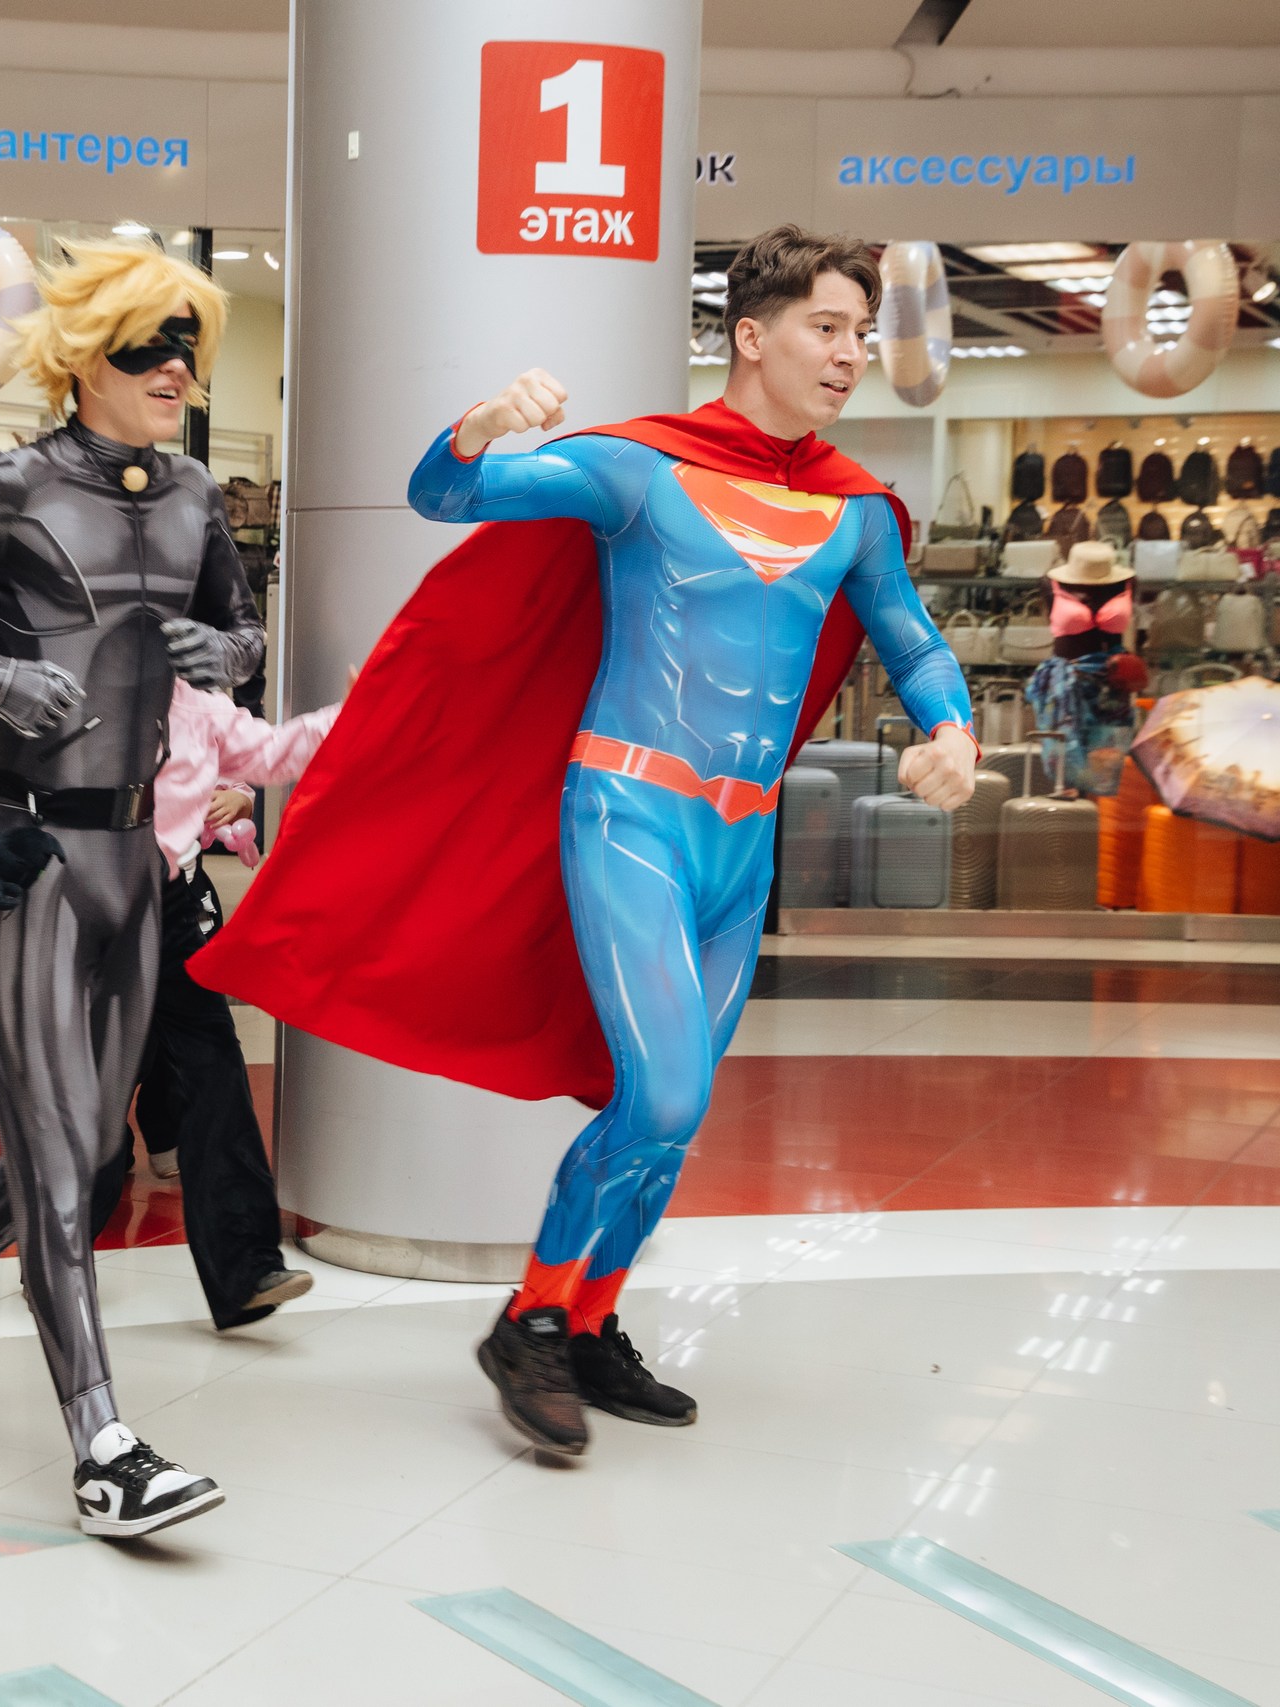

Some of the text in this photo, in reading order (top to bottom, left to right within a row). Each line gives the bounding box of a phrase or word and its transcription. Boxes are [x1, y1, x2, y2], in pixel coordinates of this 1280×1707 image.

[534, 59, 626, 198] 1
[837, 154, 1136, 196] аксессуары
[519, 205, 635, 247] этаж
